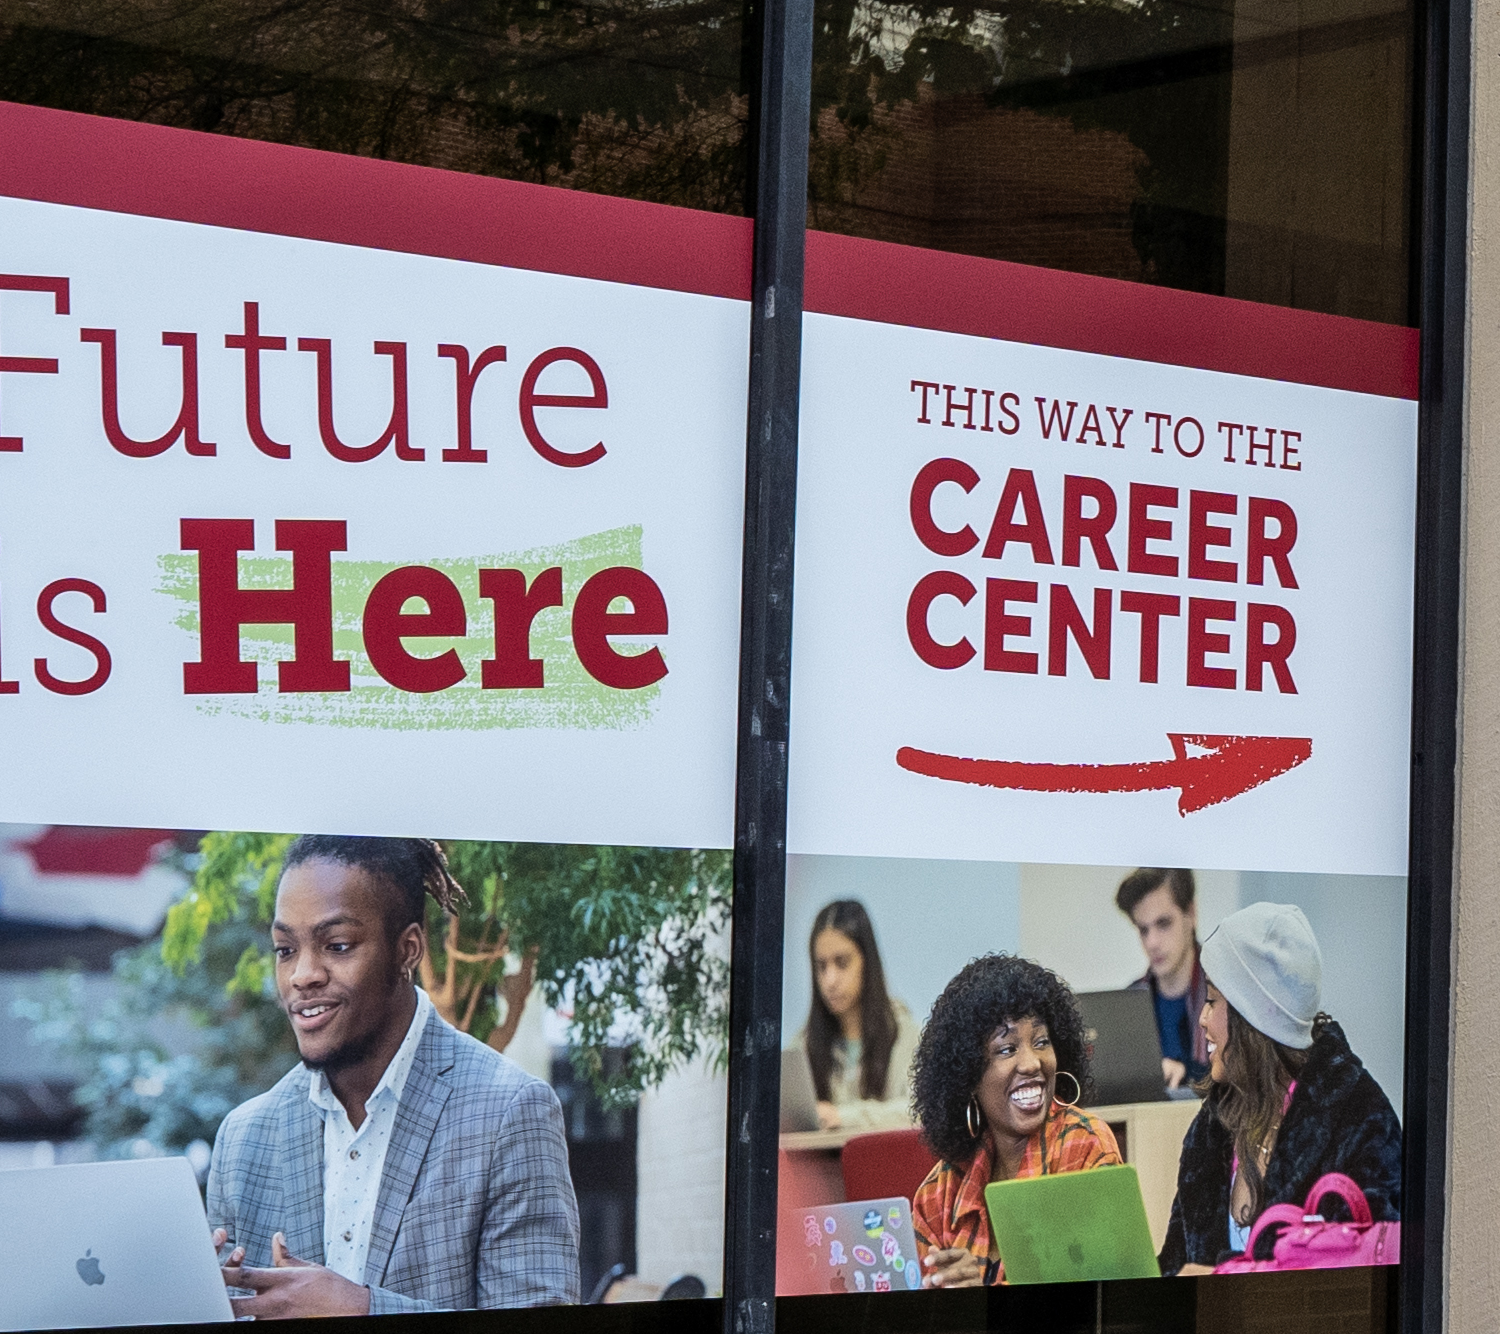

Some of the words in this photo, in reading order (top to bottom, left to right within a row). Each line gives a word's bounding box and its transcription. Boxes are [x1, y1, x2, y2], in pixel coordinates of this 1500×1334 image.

[910, 379, 1020, 435] THIS
[1034, 396, 1134, 449] WAY
[1144, 411, 1205, 458] TO
[1217, 421, 1302, 472] THE
[909, 457, 1300, 590] CAREER
[179, 518, 668, 695] Here
[906, 570, 1299, 695] CENTER
